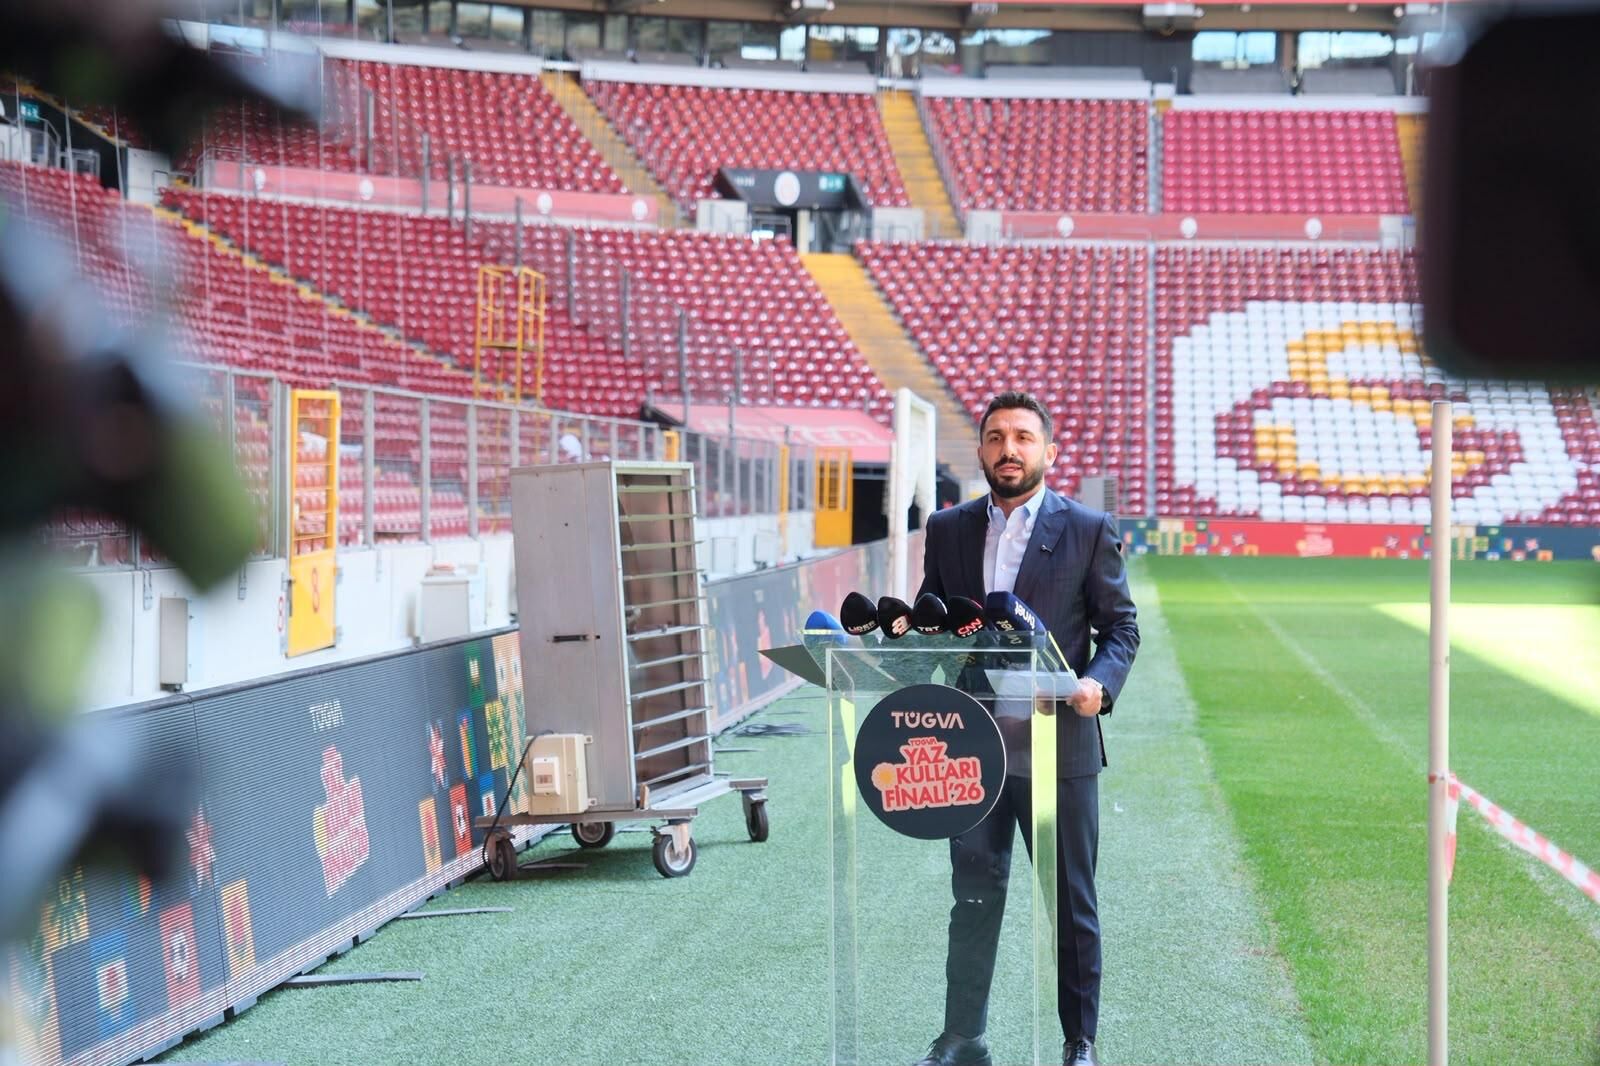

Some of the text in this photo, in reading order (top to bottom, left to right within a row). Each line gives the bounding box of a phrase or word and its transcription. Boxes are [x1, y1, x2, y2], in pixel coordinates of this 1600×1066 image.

[957, 617, 982, 635] CNN
[891, 711, 965, 729] TÜGVA
[903, 746, 945, 765] YAZ
